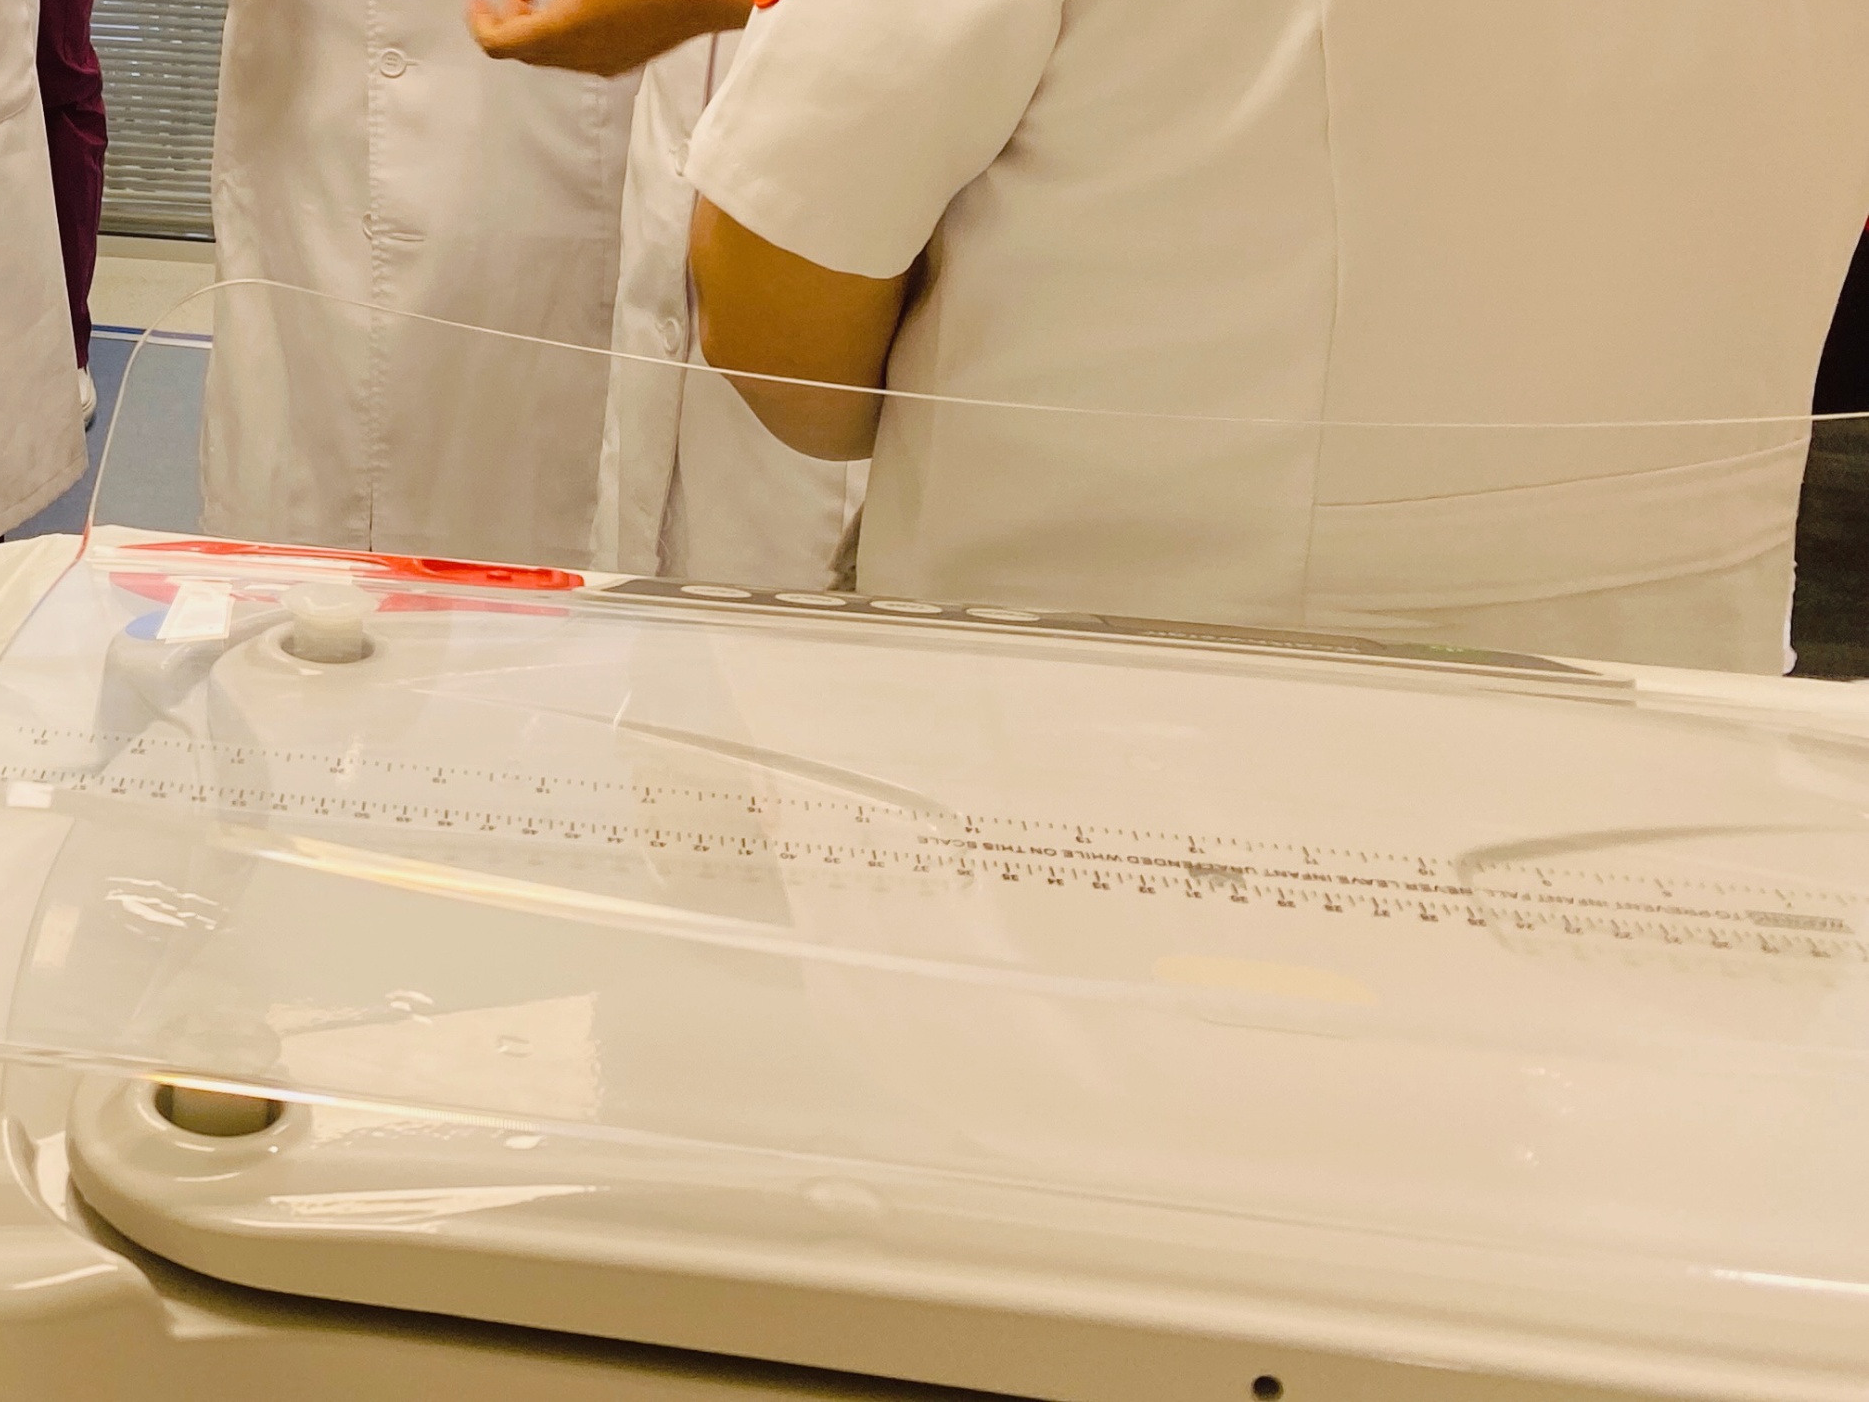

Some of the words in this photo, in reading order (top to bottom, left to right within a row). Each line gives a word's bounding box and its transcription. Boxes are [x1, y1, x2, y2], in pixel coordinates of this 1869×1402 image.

[747, 806, 763, 814] 16
[521, 828, 538, 836] 46
[965, 826, 980, 834] 14
[607, 836, 624, 844] 44
[650, 840, 667, 848] 43
[918, 836, 977, 849] SCALE
[693, 844, 710, 852] 42
[982, 842, 1025, 854] THIS
[1030, 846, 1057, 856] ON
[780, 852, 798, 860] 40
[824, 856, 840, 864] 39
[1062, 850, 1122, 862] WHILE
[1002, 873, 1019, 882] 35
[1263, 869, 1332, 883] INFANT
[1047, 878, 1064, 886] 34
[1405, 883, 1473, 895] NEVER
